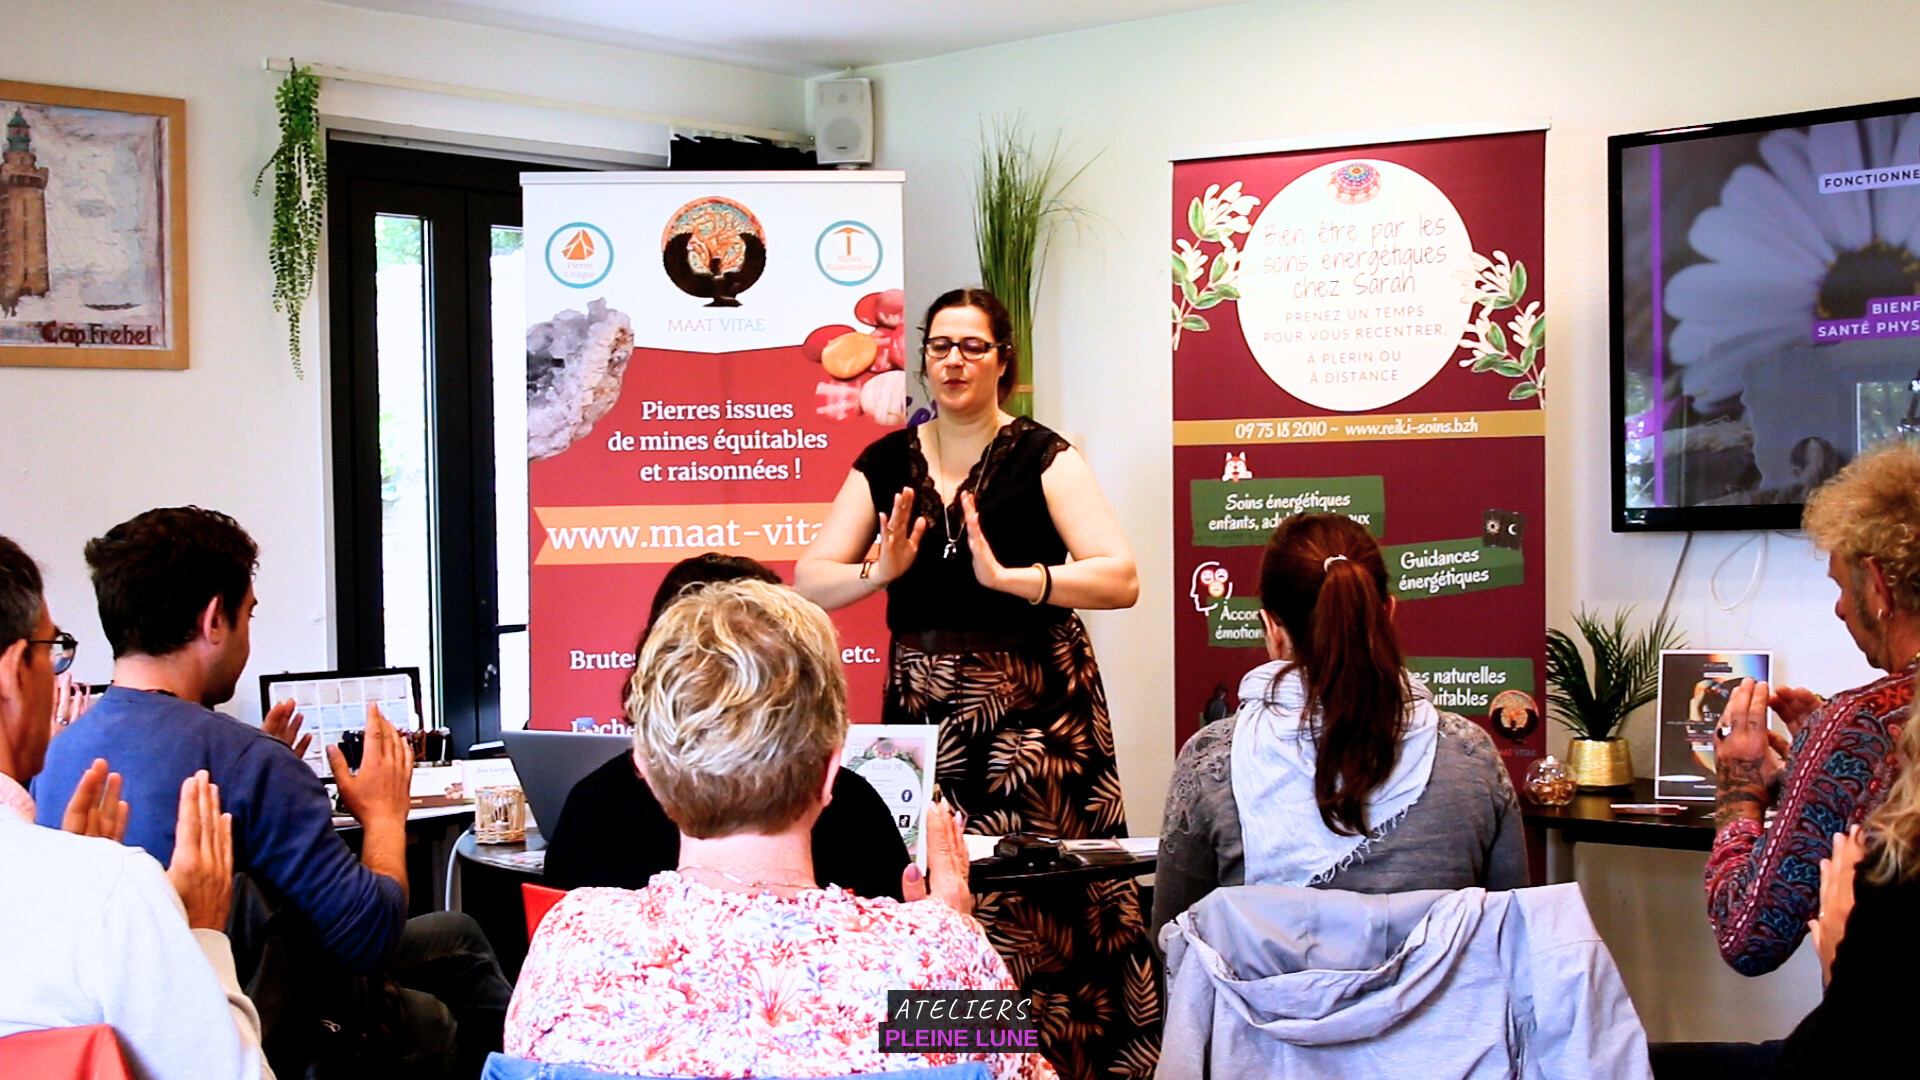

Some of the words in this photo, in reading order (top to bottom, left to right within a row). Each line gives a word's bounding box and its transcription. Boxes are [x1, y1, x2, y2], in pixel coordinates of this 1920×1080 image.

[1264, 224, 1305, 246] Bien
[1318, 221, 1358, 243] être
[1371, 221, 1405, 248] par
[1419, 213, 1446, 236] les
[1263, 254, 1308, 274] soins
[1321, 243, 1447, 275] énergétiques
[1294, 276, 1340, 298] chez
[1353, 270, 1415, 295] Sarah
[1285, 310, 1341, 323] PRENEZ
[1347, 309, 1368, 320] UN
[1375, 305, 1424, 318] TEMPS
[40, 320, 86, 347] Cap
[667, 319, 715, 331] MAAT
[720, 318, 766, 331] VITAE
[1817, 320, 1871, 337] SANTÉ
[1876, 319, 1920, 334] PHYS
[1263, 331, 1303, 343] POUR
[1309, 329, 1350, 341] VOUS
[1322, 352, 1373, 364] PLERIN
[1379, 350, 1401, 362] OU
[1324, 370, 1399, 384] DISTANCE
[641, 401, 720, 420] Pierres
[726, 400, 793, 419] issues
[1235, 423, 1255, 439] 09
[1256, 423, 1274, 438] 75
[1292, 421, 1327, 437] 2010
[1345, 416, 1478, 436] www.reiki-soins.bzh
[607, 431, 635, 451] de
[639, 431, 709, 451] mines
[713, 429, 828, 454] équitables
[640, 463, 662, 481] et
[667, 458, 789, 481] raisonnées
[794, 457, 801, 479] !
[1225, 493, 1264, 511] Soins
[1266, 490, 1351, 514] énergétiques
[1208, 514, 1259, 531] enfants,
[1400, 549, 1480, 570] Guidances
[1399, 567, 1490, 593] énergétiques
[841, 645, 881, 663] etc.
[1433, 665, 1506, 684] naturelles
